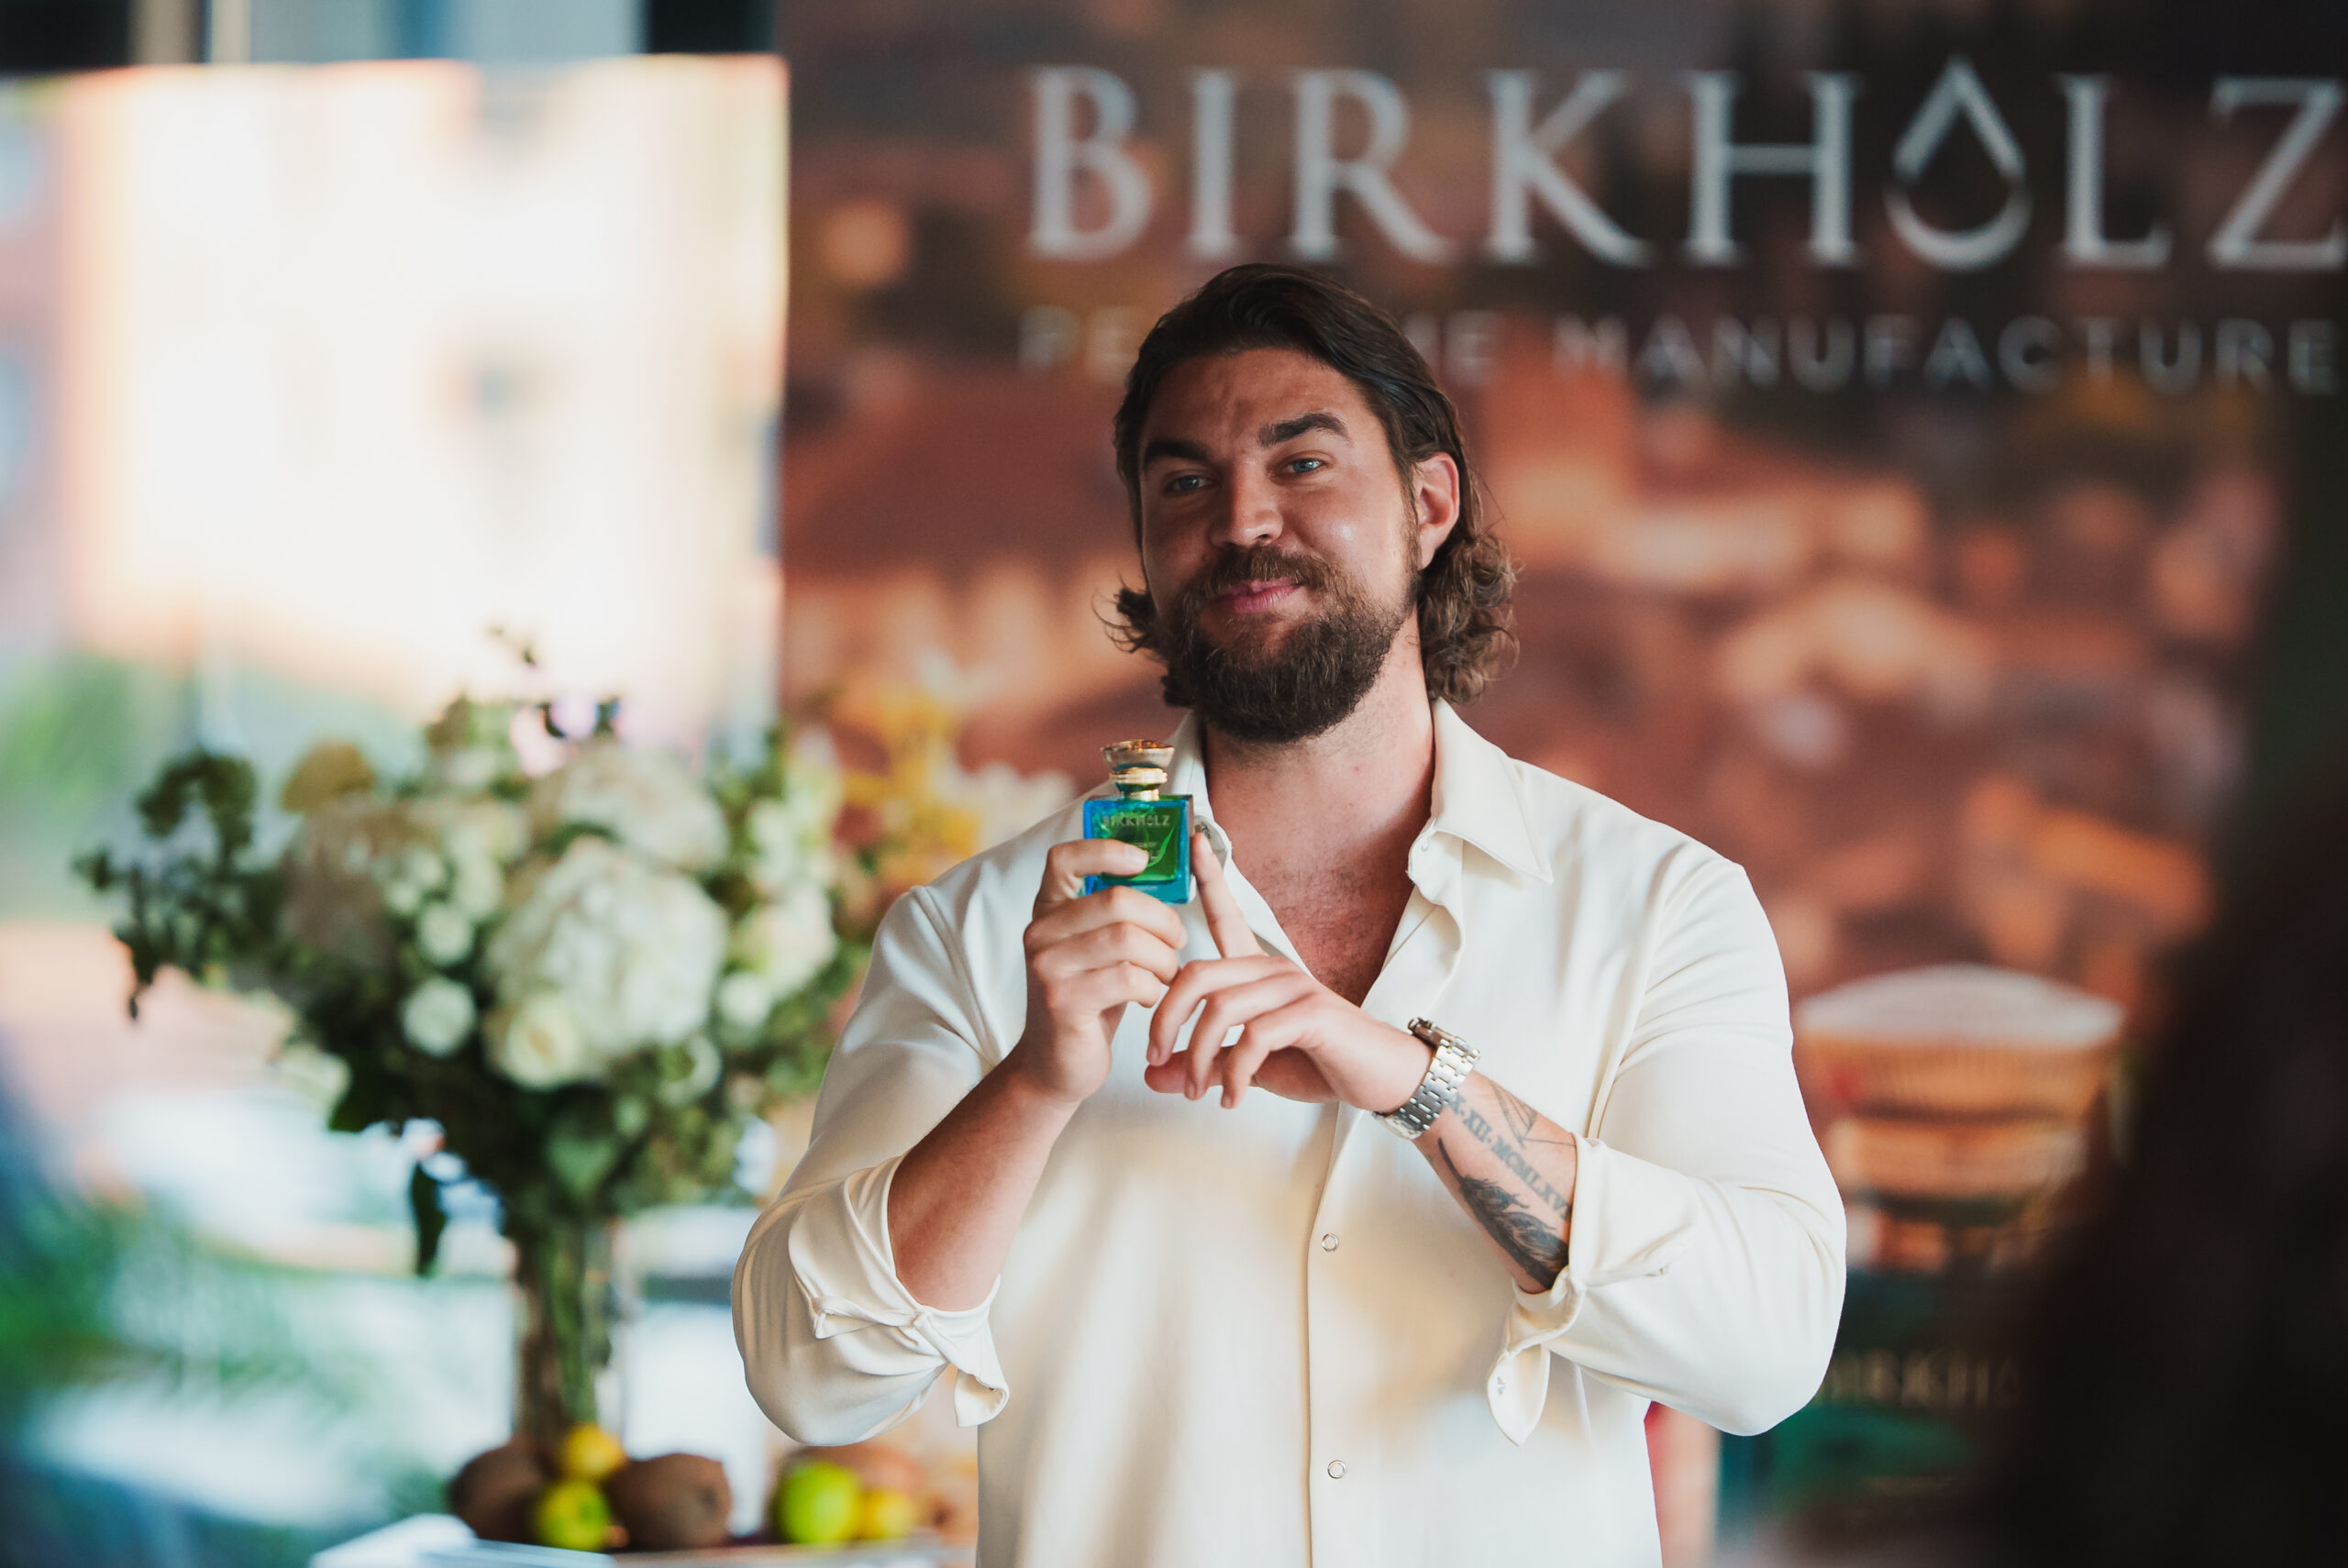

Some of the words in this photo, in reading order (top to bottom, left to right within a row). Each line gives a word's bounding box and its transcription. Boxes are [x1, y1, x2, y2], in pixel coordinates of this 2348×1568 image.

[1025, 57, 2347, 270] BIRKHOLZ
[1551, 312, 2339, 393] MANUFACTURE
[1102, 814, 1170, 827] BIRKHOLZ
